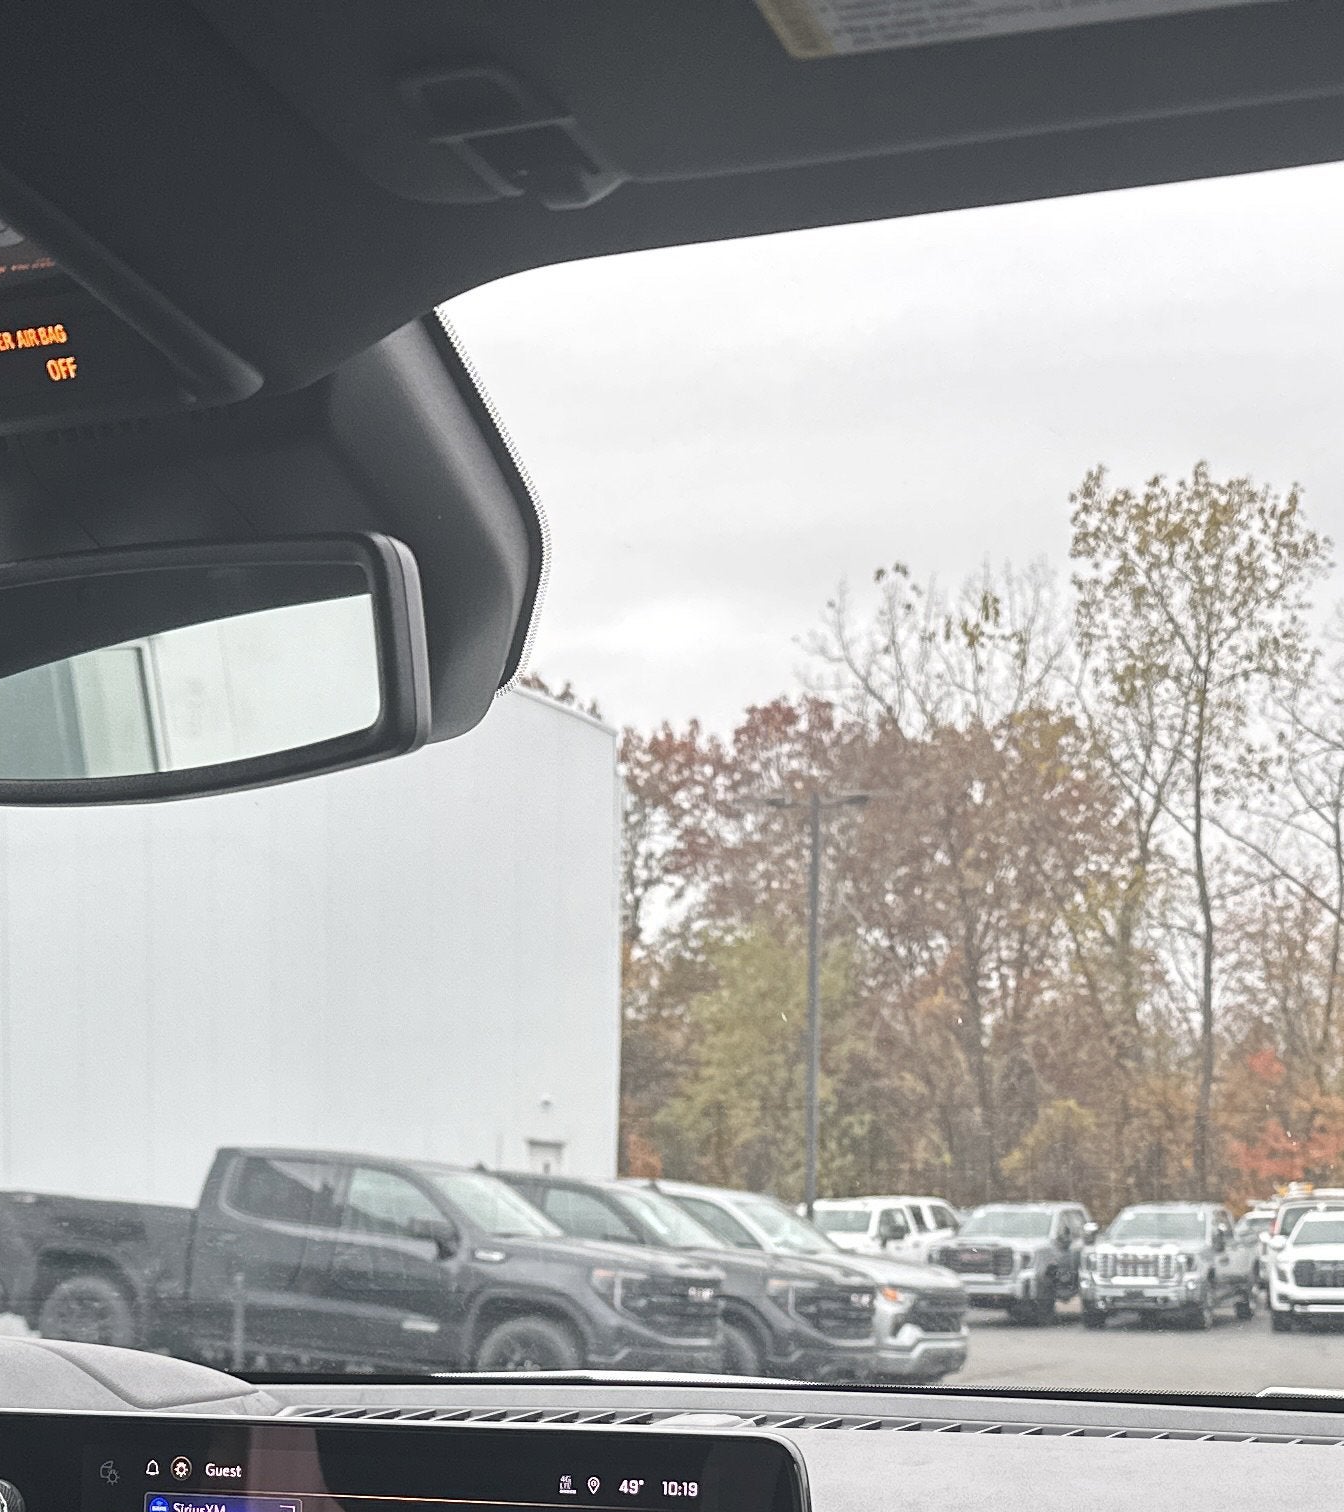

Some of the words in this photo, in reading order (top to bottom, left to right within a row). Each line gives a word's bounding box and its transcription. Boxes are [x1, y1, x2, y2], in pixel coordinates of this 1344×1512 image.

[16, 328, 39, 349] AIR
[38, 324, 68, 345] BAG
[45, 356, 77, 381] OFF
[205, 1463, 242, 1478] Guest
[662, 1481, 698, 1497] 10:19
